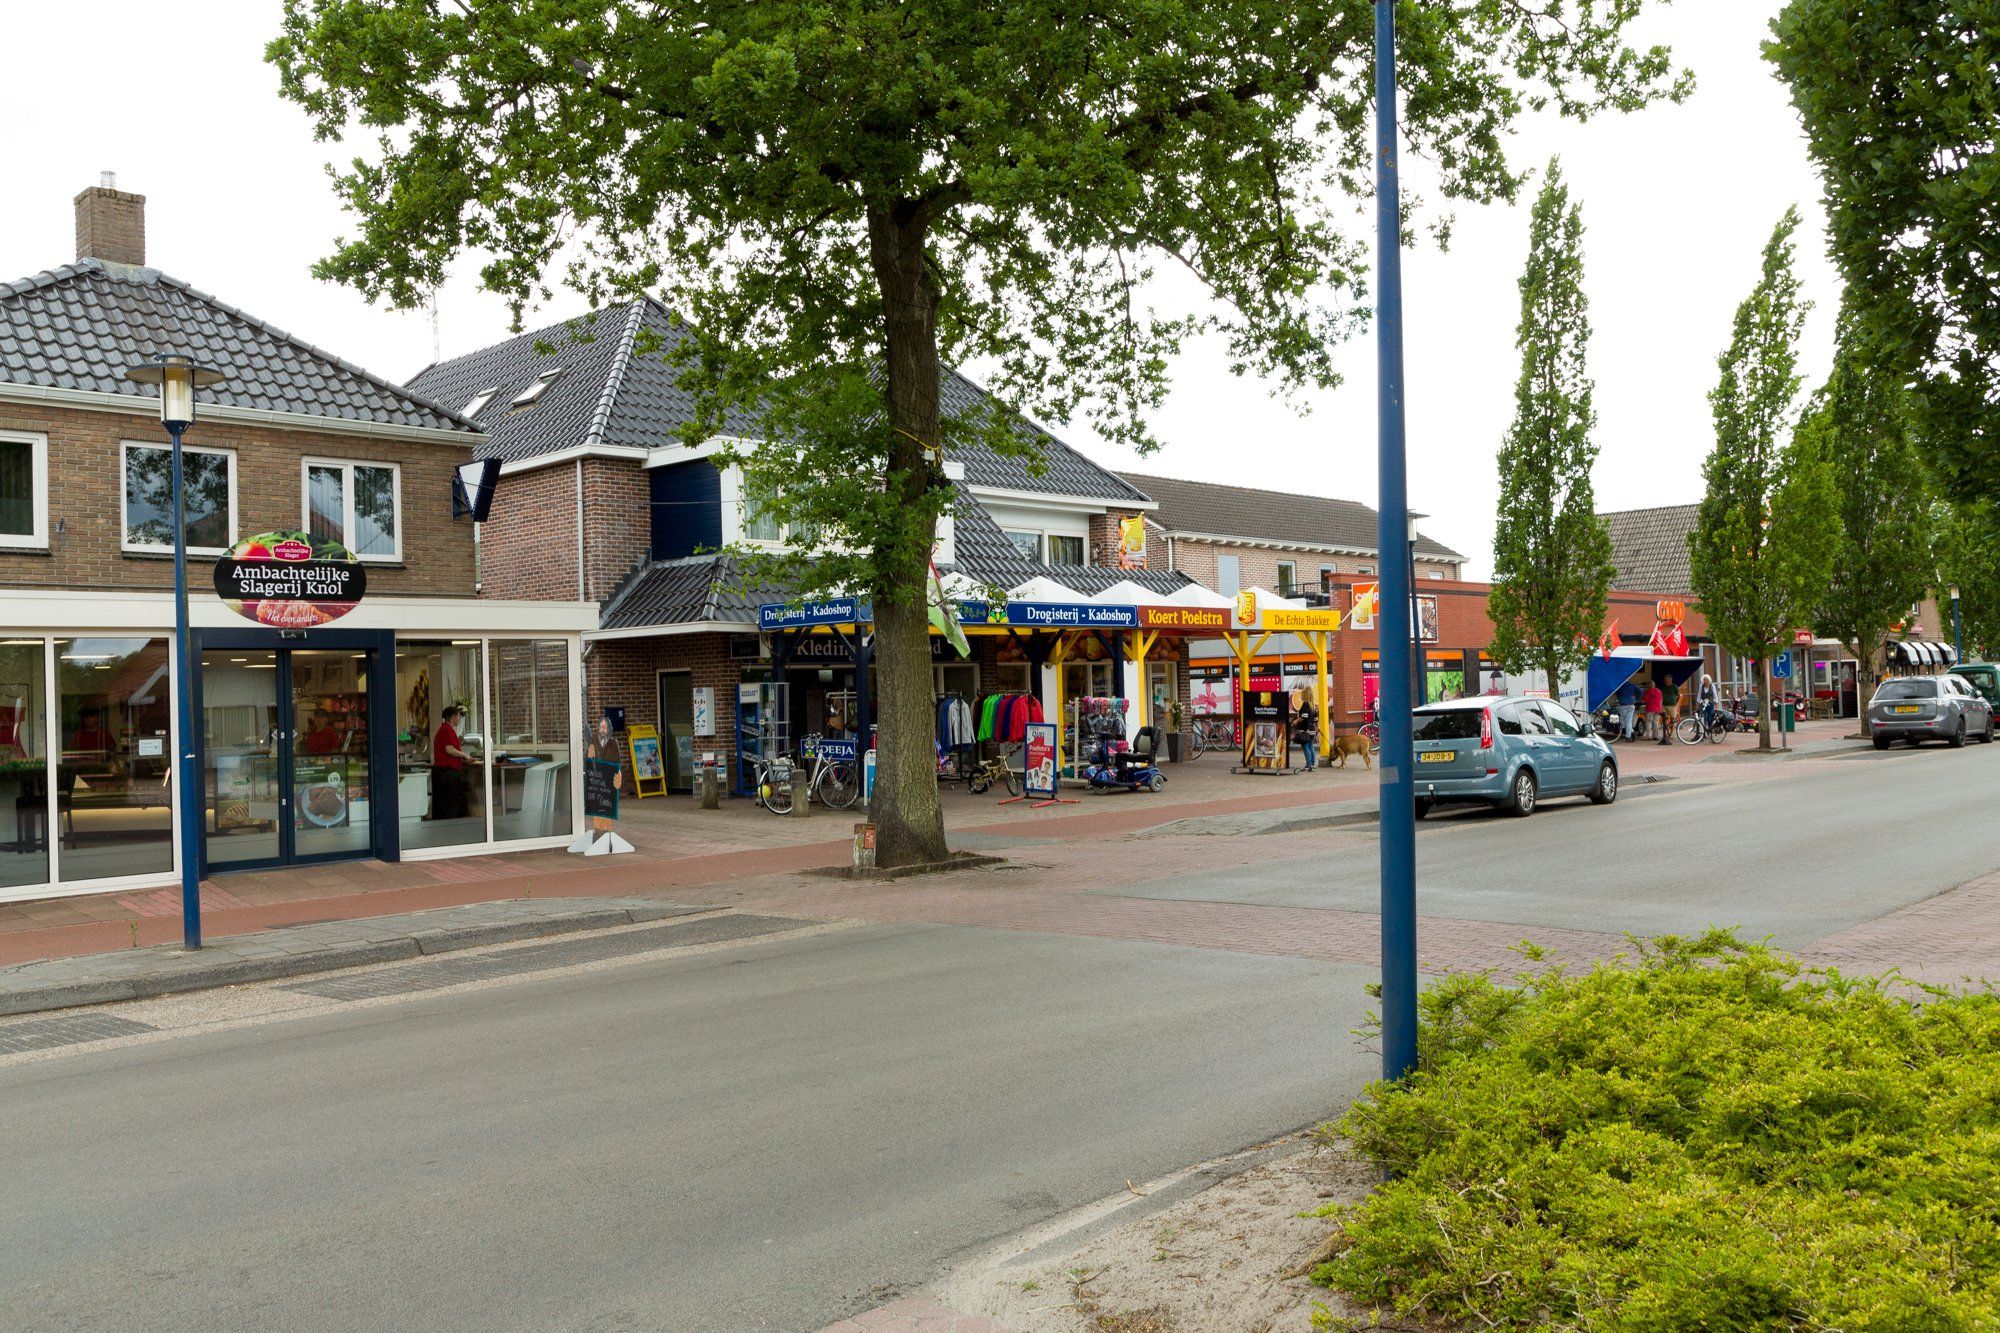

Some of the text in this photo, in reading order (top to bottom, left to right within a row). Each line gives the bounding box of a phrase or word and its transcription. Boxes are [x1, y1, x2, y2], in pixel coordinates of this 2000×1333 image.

[232, 565, 350, 584] Ambachtelijke
[240, 580, 343, 597] Slagerij Knol
[764, 605, 806, 624] Drogisterij
[813, 604, 852, 619] Kadoshop
[1026, 606, 1080, 624] Drogisterij
[1088, 608, 1132, 625] Kadoshop
[1148, 609, 1224, 626] Koert Poelstra
[1274, 614, 1330, 626] De Echte Bakker
[1776, 655, 1787, 668] P
